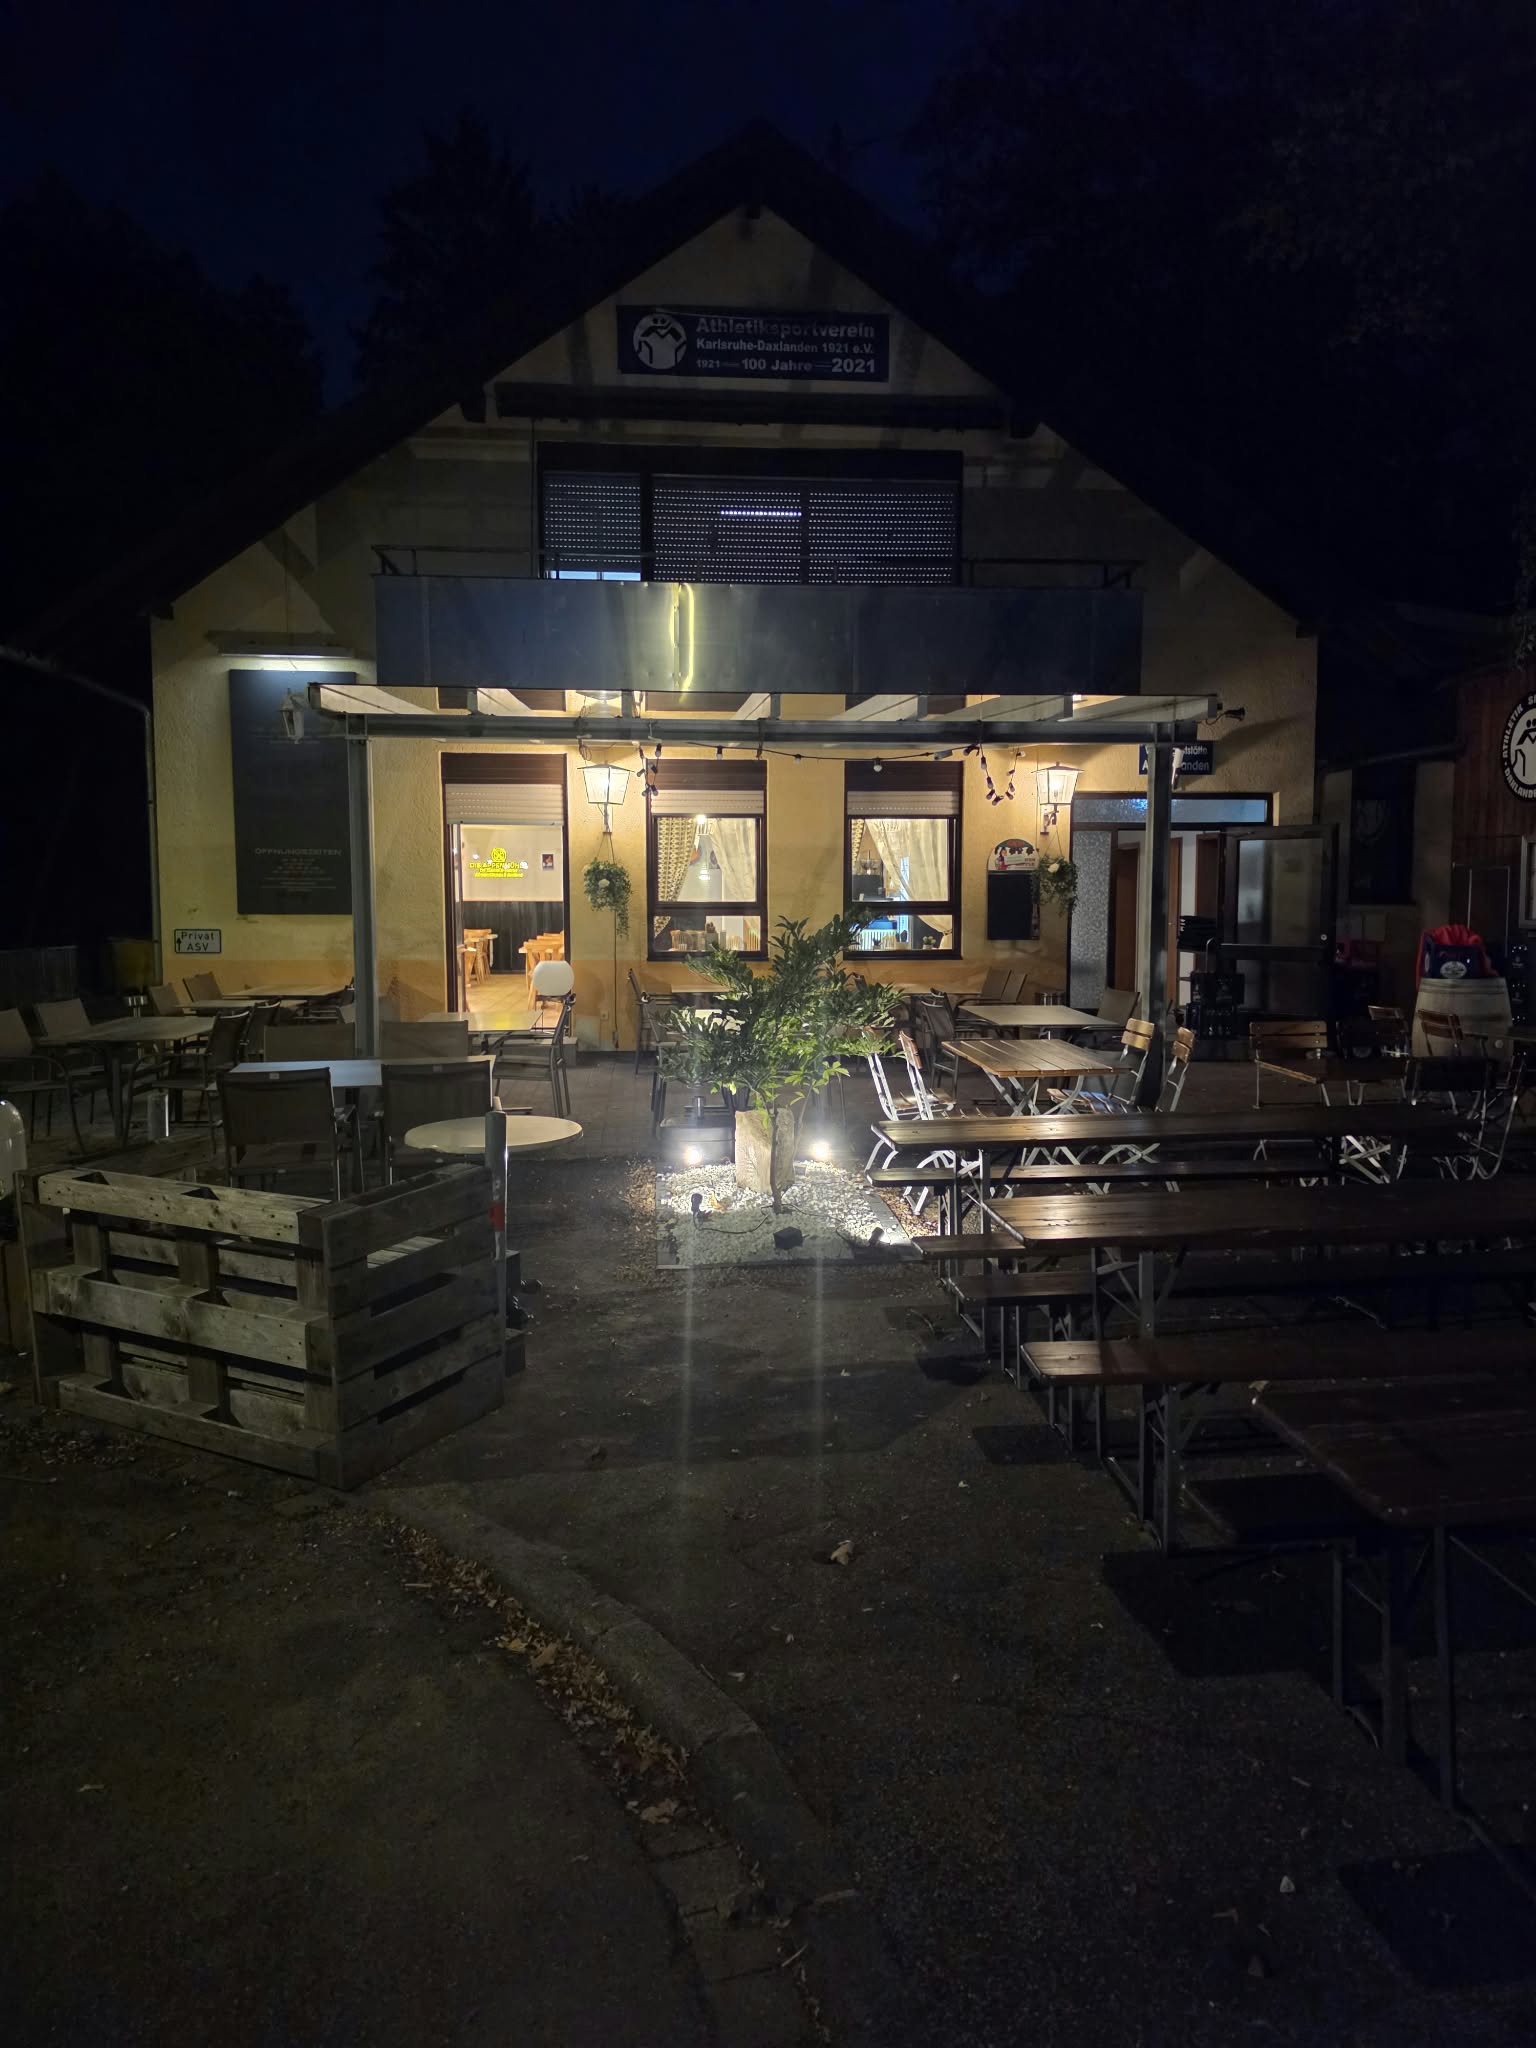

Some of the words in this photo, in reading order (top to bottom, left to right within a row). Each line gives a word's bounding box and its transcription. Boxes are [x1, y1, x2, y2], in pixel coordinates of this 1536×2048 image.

[696, 318, 875, 339] Athletiksportverein
[696, 338, 818, 353] Karlsruhe-Daxlanden
[822, 342, 849, 353] 1921
[852, 343, 875, 354] e.V.
[696, 359, 720, 369] 1921
[741, 358, 767, 370] 100
[771, 360, 813, 371] Jahre
[831, 358, 875, 373] 2021
[181, 931, 215, 940] Privat
[187, 942, 209, 952] ASV
